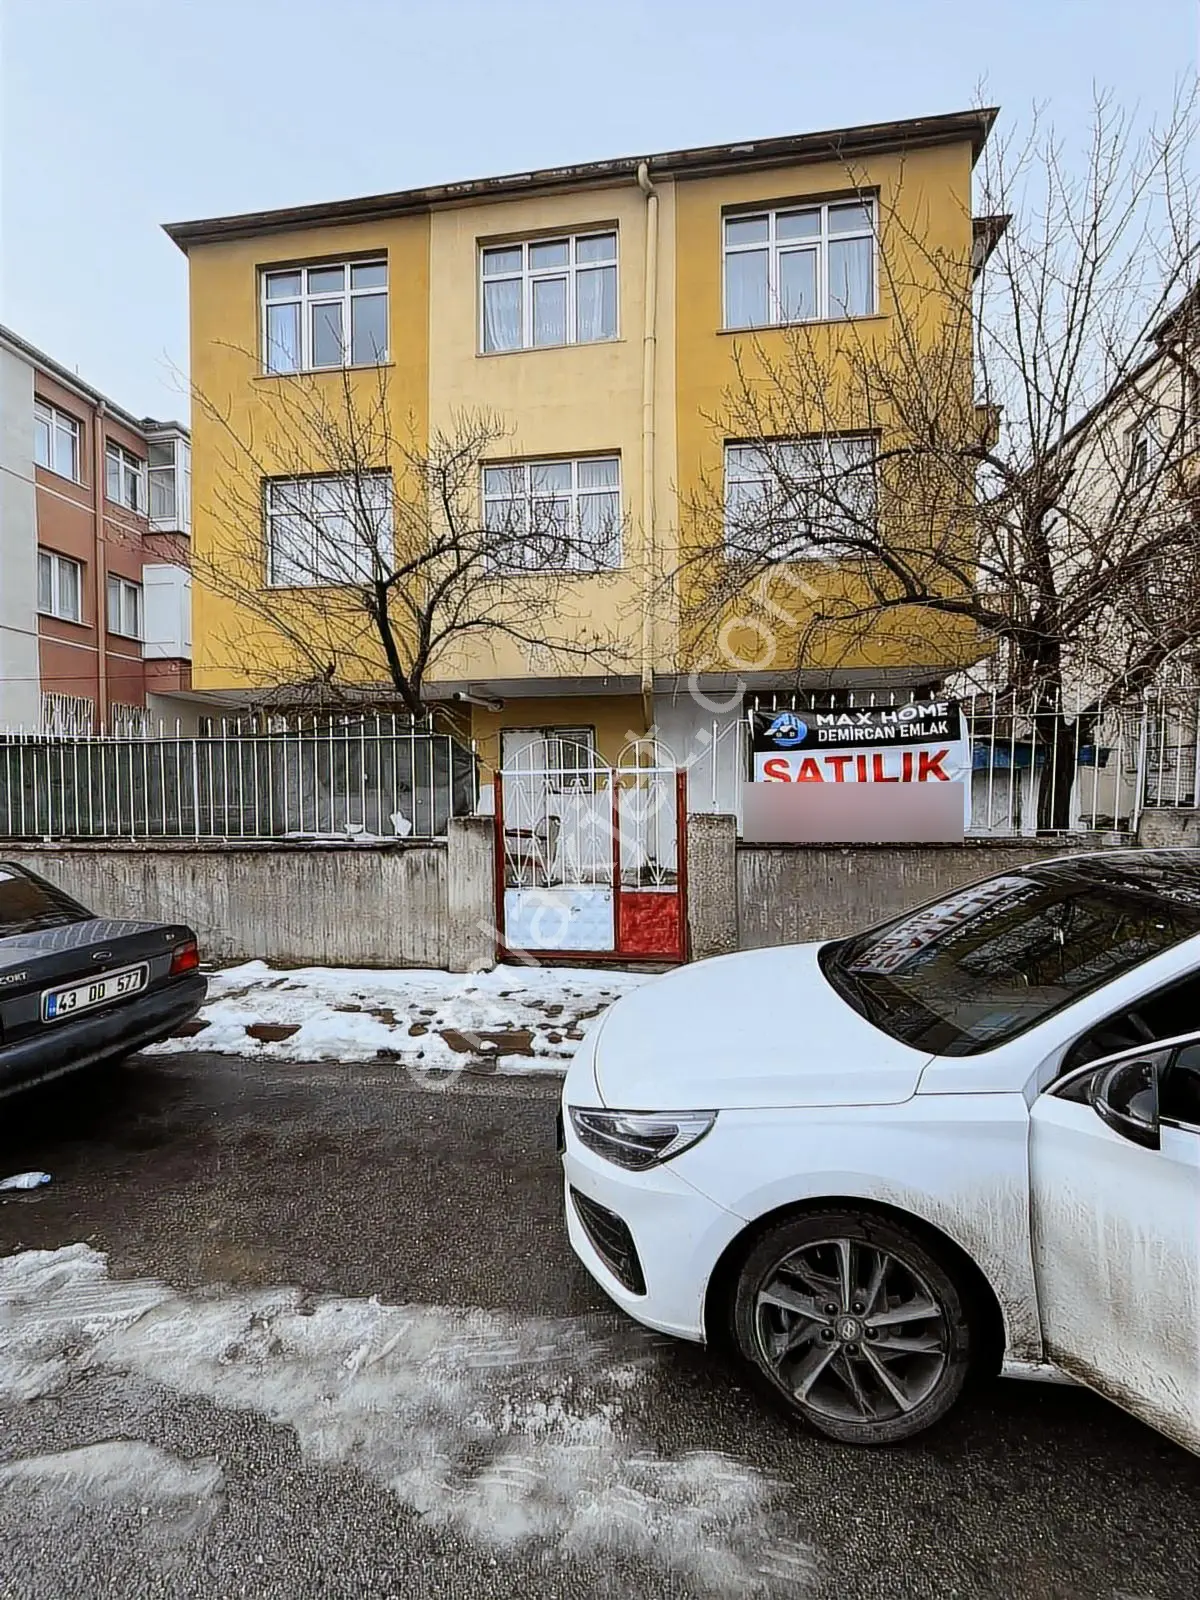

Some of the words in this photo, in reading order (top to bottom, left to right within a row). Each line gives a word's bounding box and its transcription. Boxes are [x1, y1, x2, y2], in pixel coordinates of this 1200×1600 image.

[816, 711, 873, 726] MAX
[881, 702, 949, 724] HOME
[818, 724, 896, 742] DEMİRCAN
[900, 720, 949, 737] EMLAK
[763, 749, 951, 782] SATILIK
[59, 992, 77, 1010] 43
[89, 983, 105, 1002] DD
[117, 972, 139, 992] 577
